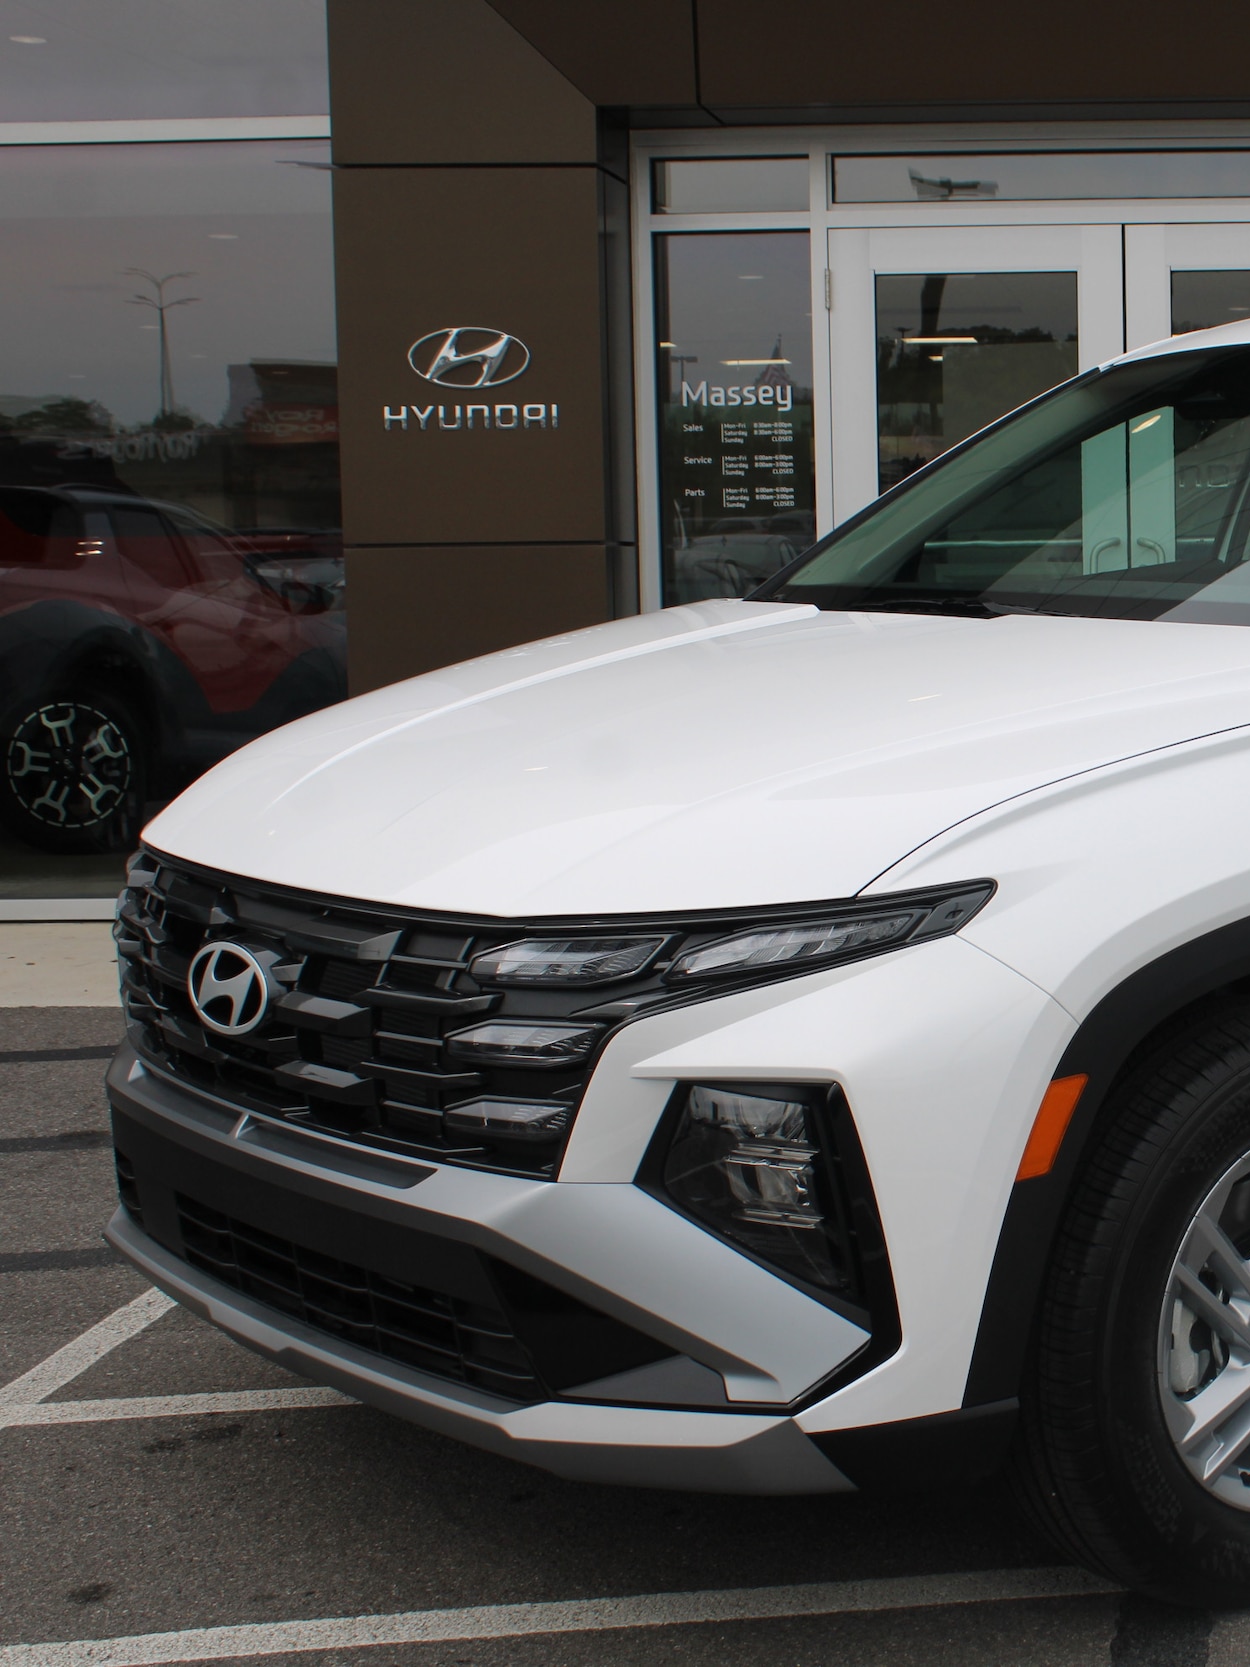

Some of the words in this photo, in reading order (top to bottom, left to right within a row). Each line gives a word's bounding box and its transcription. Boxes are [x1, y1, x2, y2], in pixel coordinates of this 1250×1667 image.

[681, 380, 792, 411] Massey
[383, 403, 559, 431] HYUNDAI
[683, 424, 704, 433] Sales
[684, 456, 712, 465] Service
[685, 489, 705, 497] Parts
